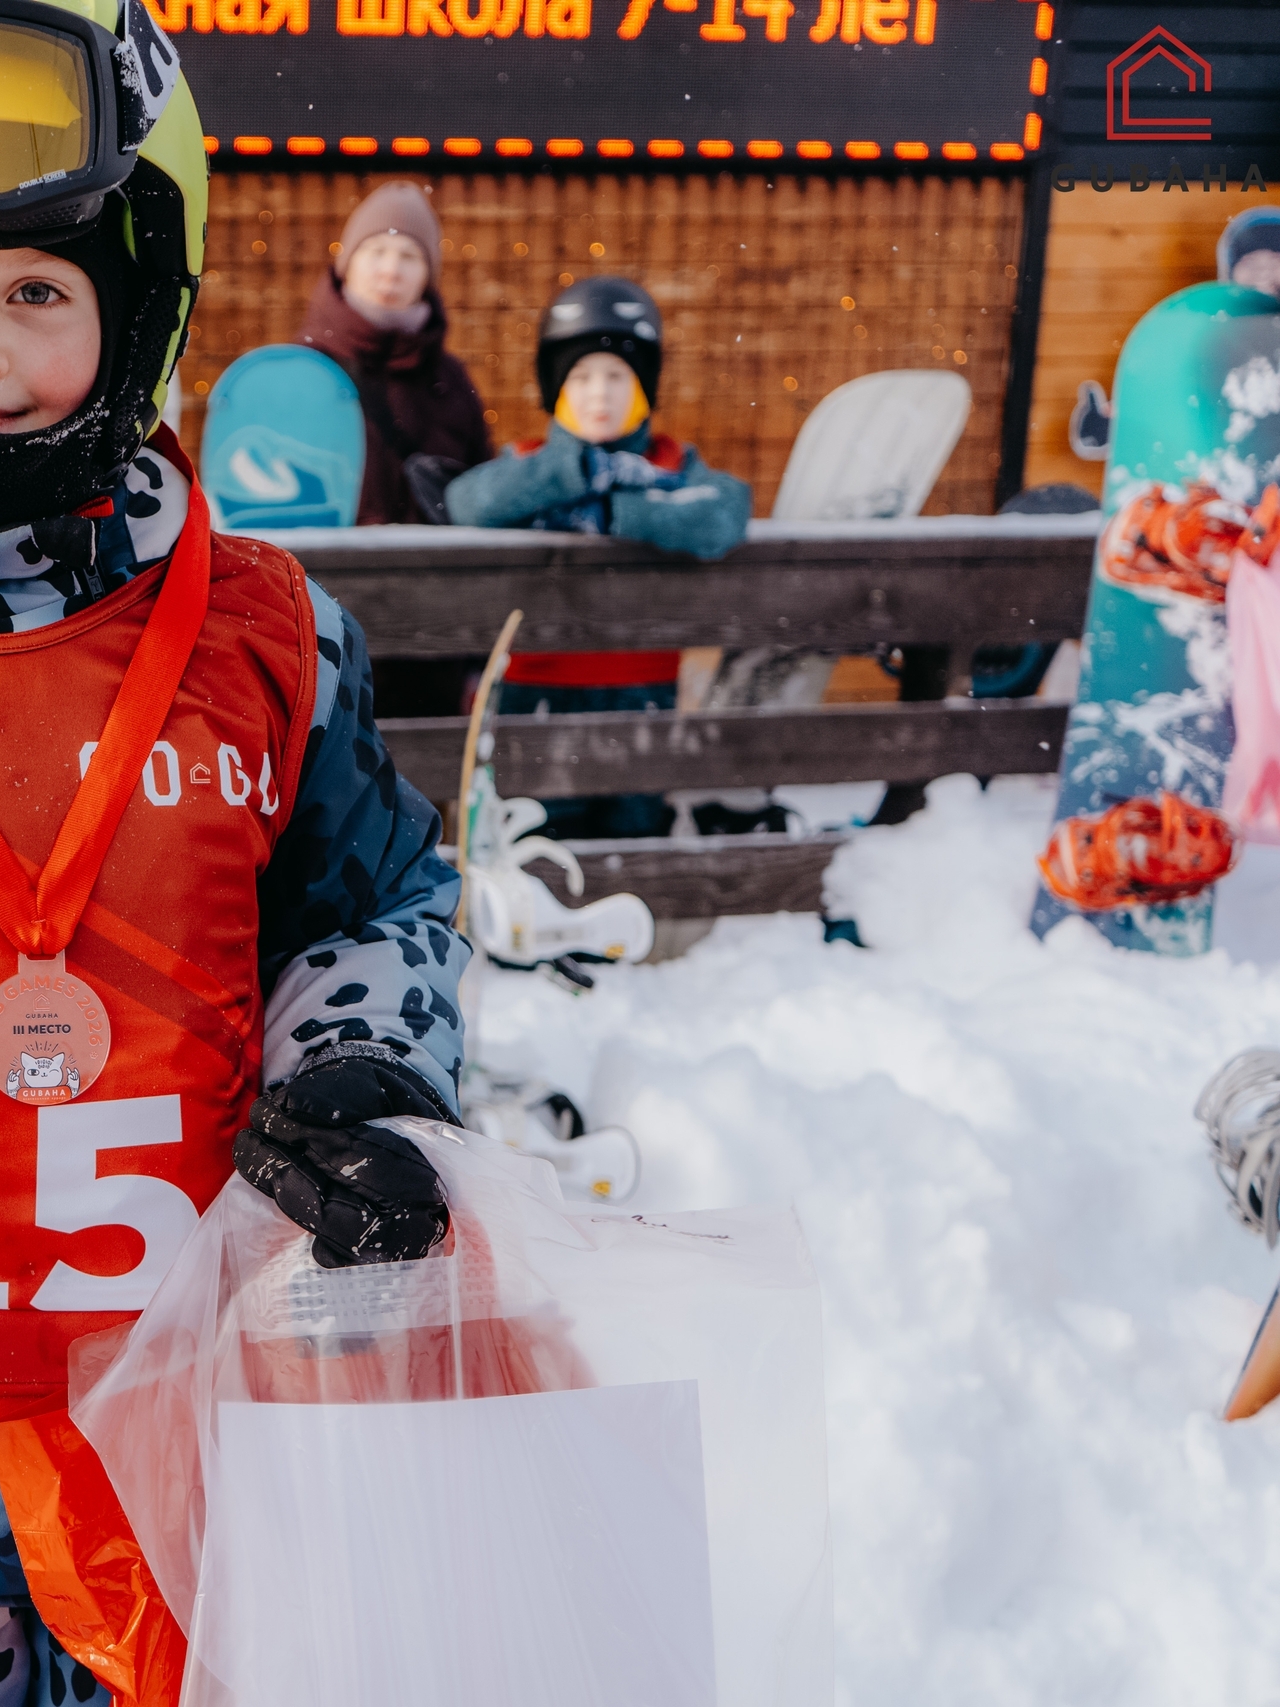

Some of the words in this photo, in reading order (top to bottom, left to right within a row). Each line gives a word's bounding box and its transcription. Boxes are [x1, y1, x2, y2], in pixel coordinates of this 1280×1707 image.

[140, 0, 309, 35] ная
[18, 177, 44, 190] DOUBLE
[3, 975, 79, 1001] GAMES
[12, 1025, 25, 1035] III
[27, 1024, 72, 1035] МЕСТО
[22, 1089, 66, 1097] GUBAHA
